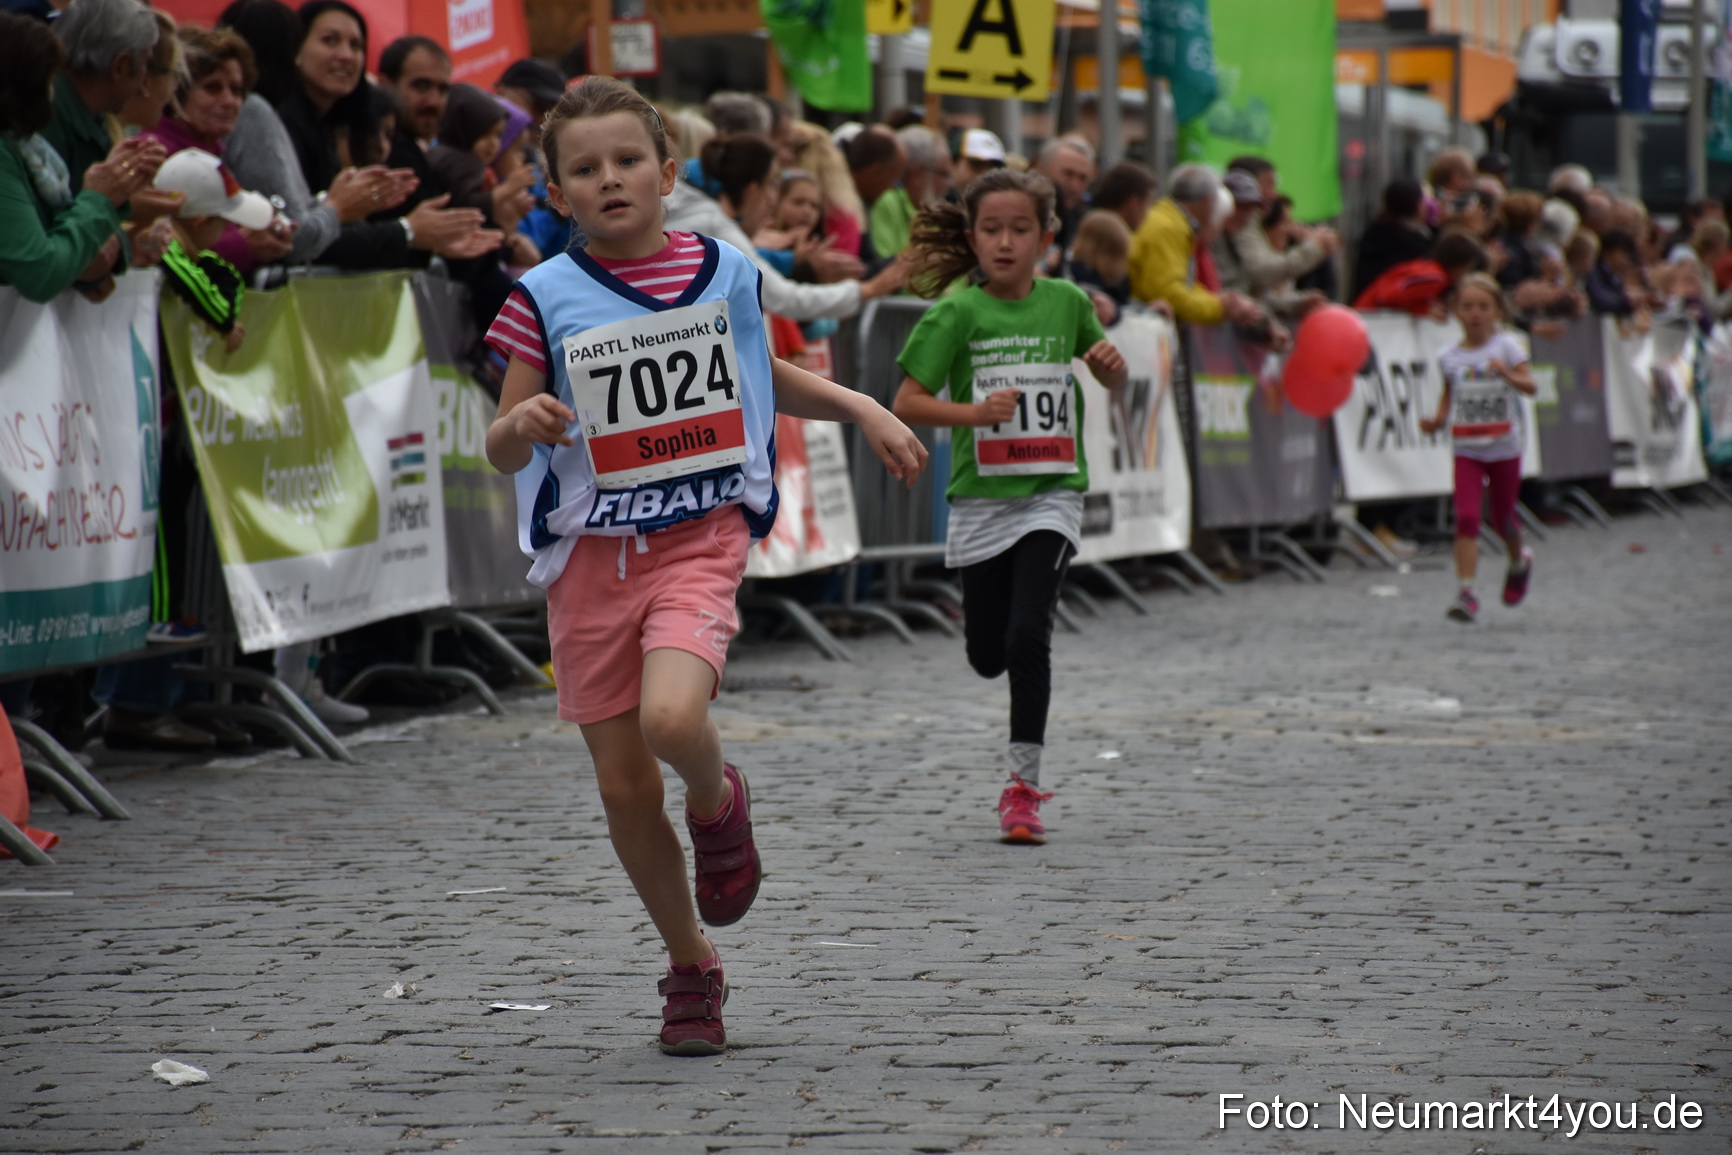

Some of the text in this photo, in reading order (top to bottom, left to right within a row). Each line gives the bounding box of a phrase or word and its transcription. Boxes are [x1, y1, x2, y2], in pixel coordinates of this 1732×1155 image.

[955, 0, 1026, 58] A
[570, 322, 711, 364] PARTL Neumarkt
[589, 344, 735, 425] 7024
[589, 425, 598, 436] 3
[985, 391, 1069, 434] 194
[638, 426, 717, 460] Sophia
[1008, 444, 1060, 459] Antonia
